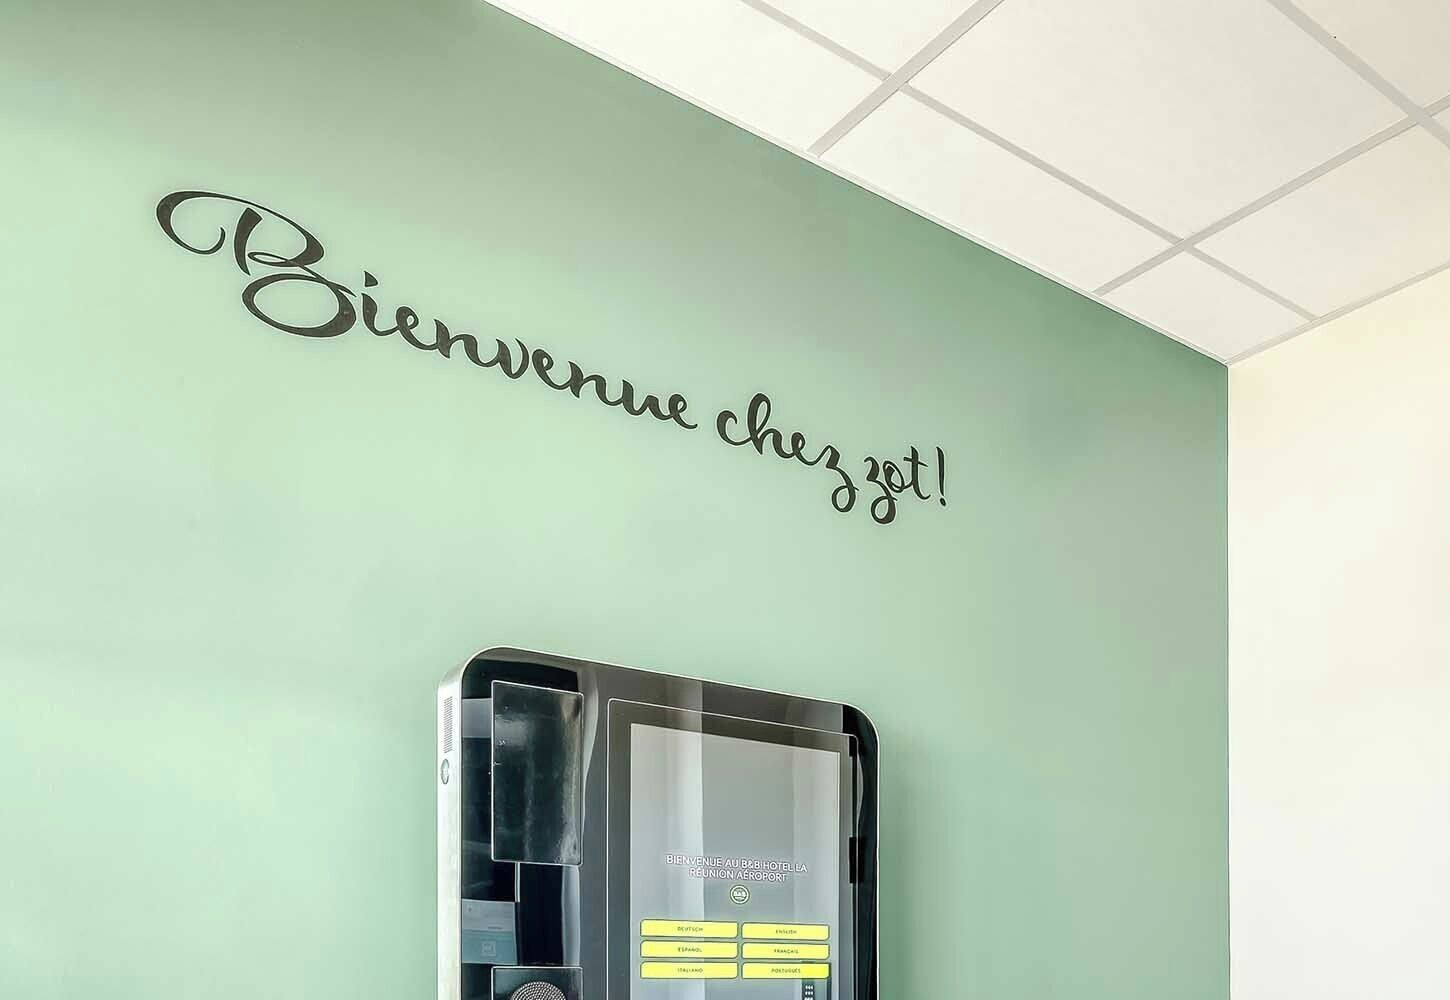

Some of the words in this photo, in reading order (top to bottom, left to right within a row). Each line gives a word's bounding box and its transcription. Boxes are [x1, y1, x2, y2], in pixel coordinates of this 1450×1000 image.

[156, 189, 698, 430] Bienvenue
[716, 392, 860, 513] chez
[666, 854, 722, 867] BIENVENUE
[725, 858, 739, 868] AU
[741, 859, 761, 870] B&B
[763, 861, 794, 872] HOTEL
[795, 863, 808, 873] LA
[736, 870, 787, 882] AÉROPORT
